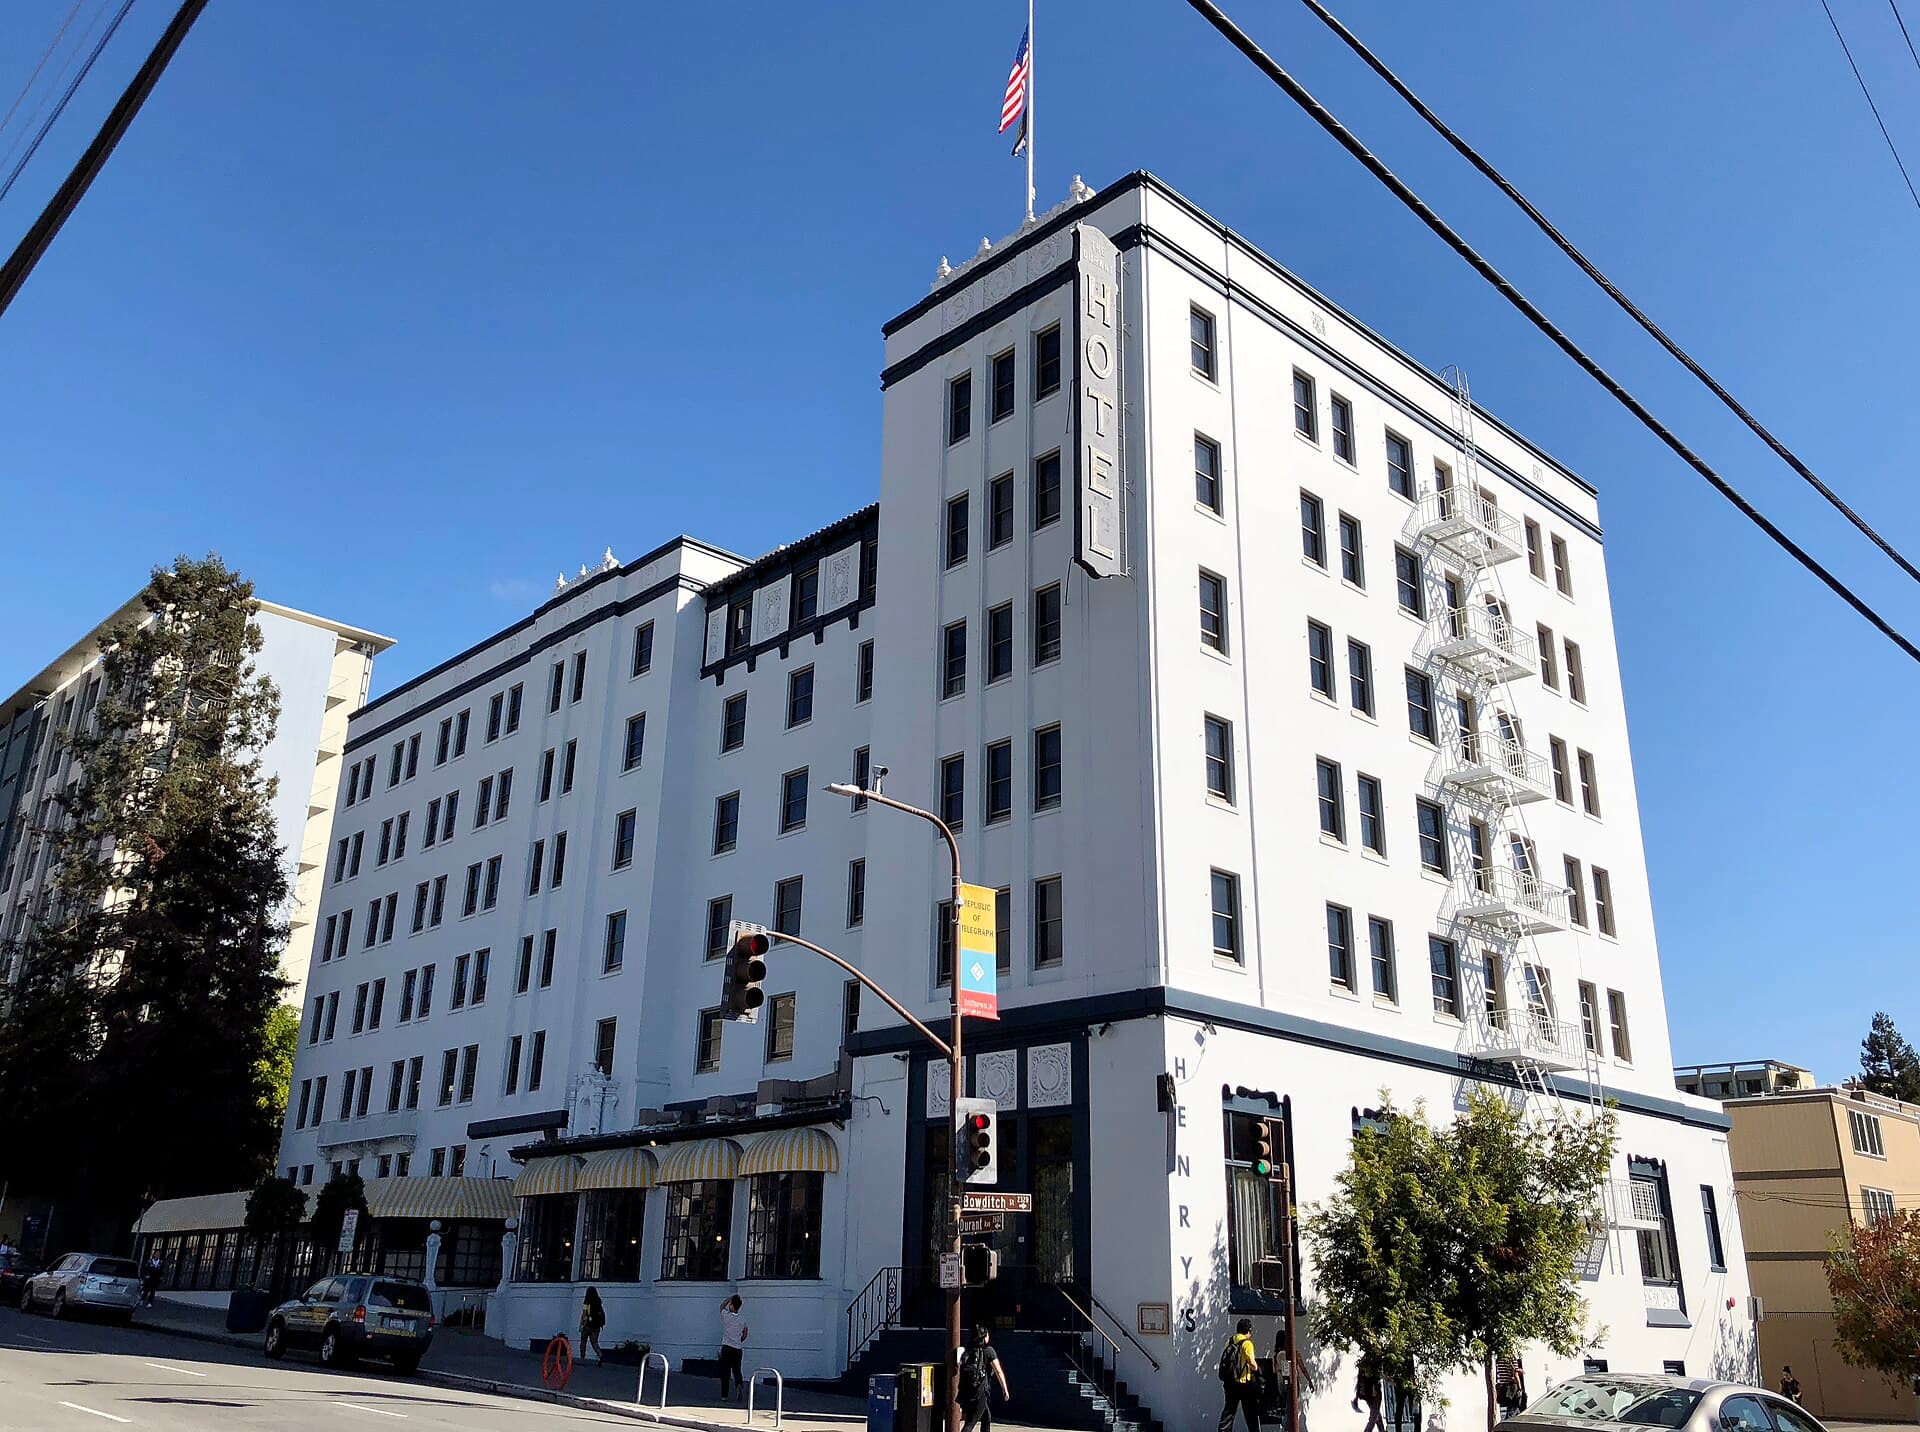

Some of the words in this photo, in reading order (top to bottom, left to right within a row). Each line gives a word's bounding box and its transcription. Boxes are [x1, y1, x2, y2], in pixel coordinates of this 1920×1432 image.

[1086, 273, 1113, 560] HOTEL
[964, 899, 992, 912] REPUBLIC
[972, 913, 982, 923] OF
[961, 923, 995, 938] TELEGRAPH
[963, 1194, 1006, 1209] Bowditch
[960, 1217, 983, 1232] Durant
